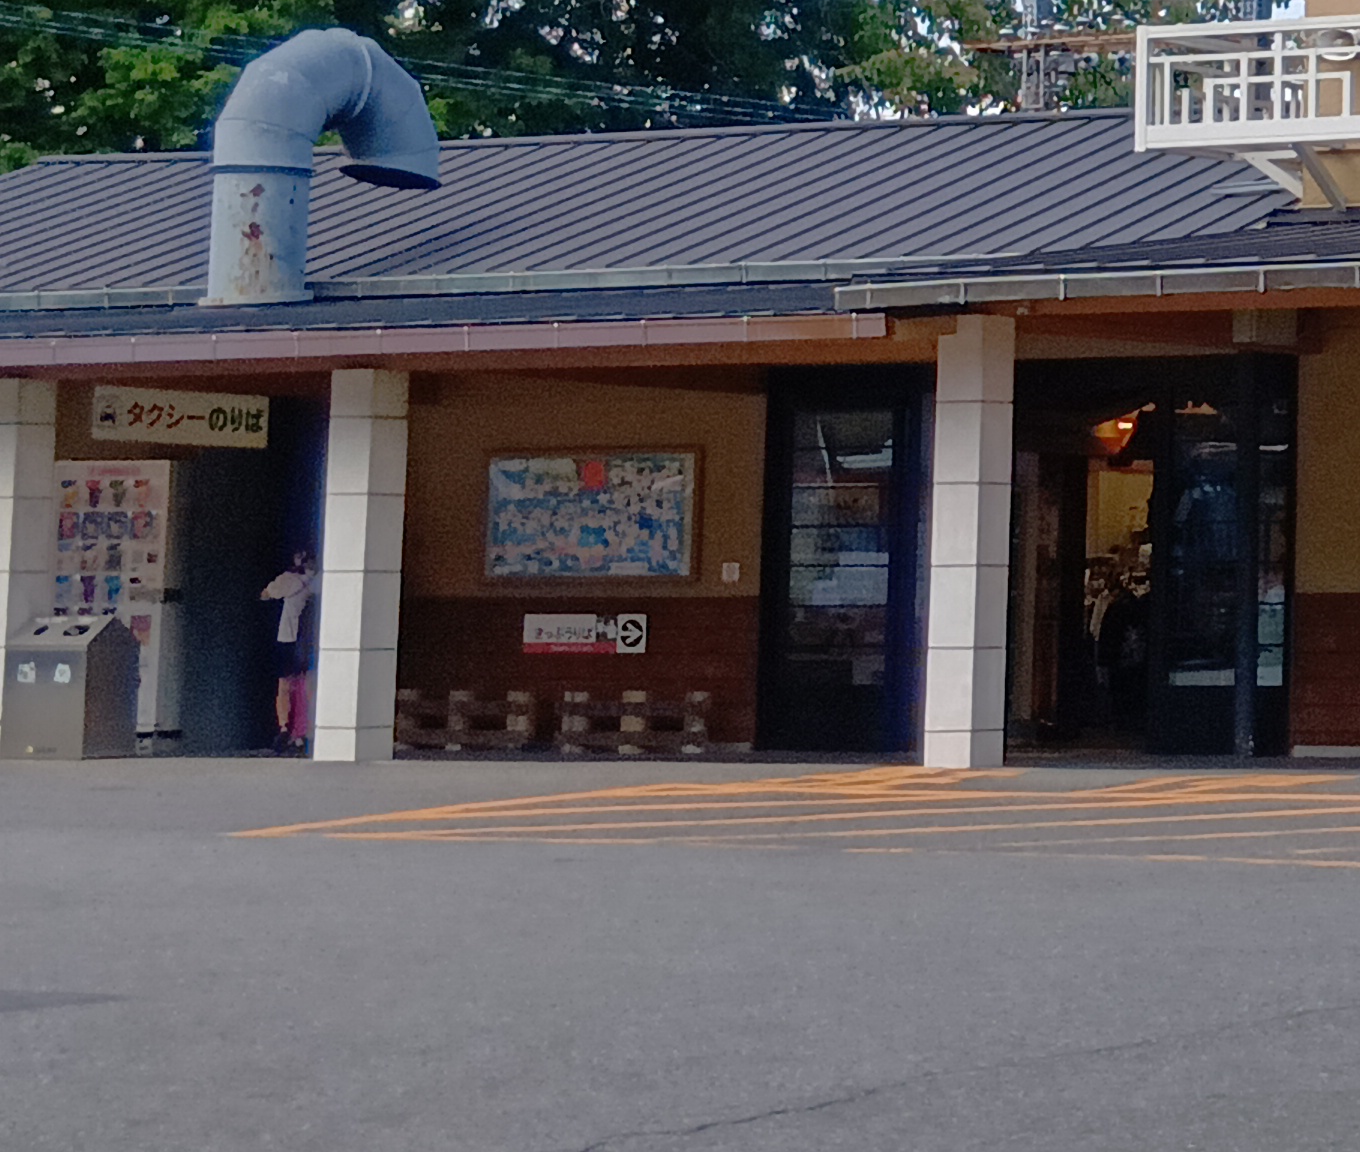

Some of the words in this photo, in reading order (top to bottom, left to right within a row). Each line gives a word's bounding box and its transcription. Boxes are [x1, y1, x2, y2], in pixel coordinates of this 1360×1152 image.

[126, 401, 265, 434] タクシーのりば
